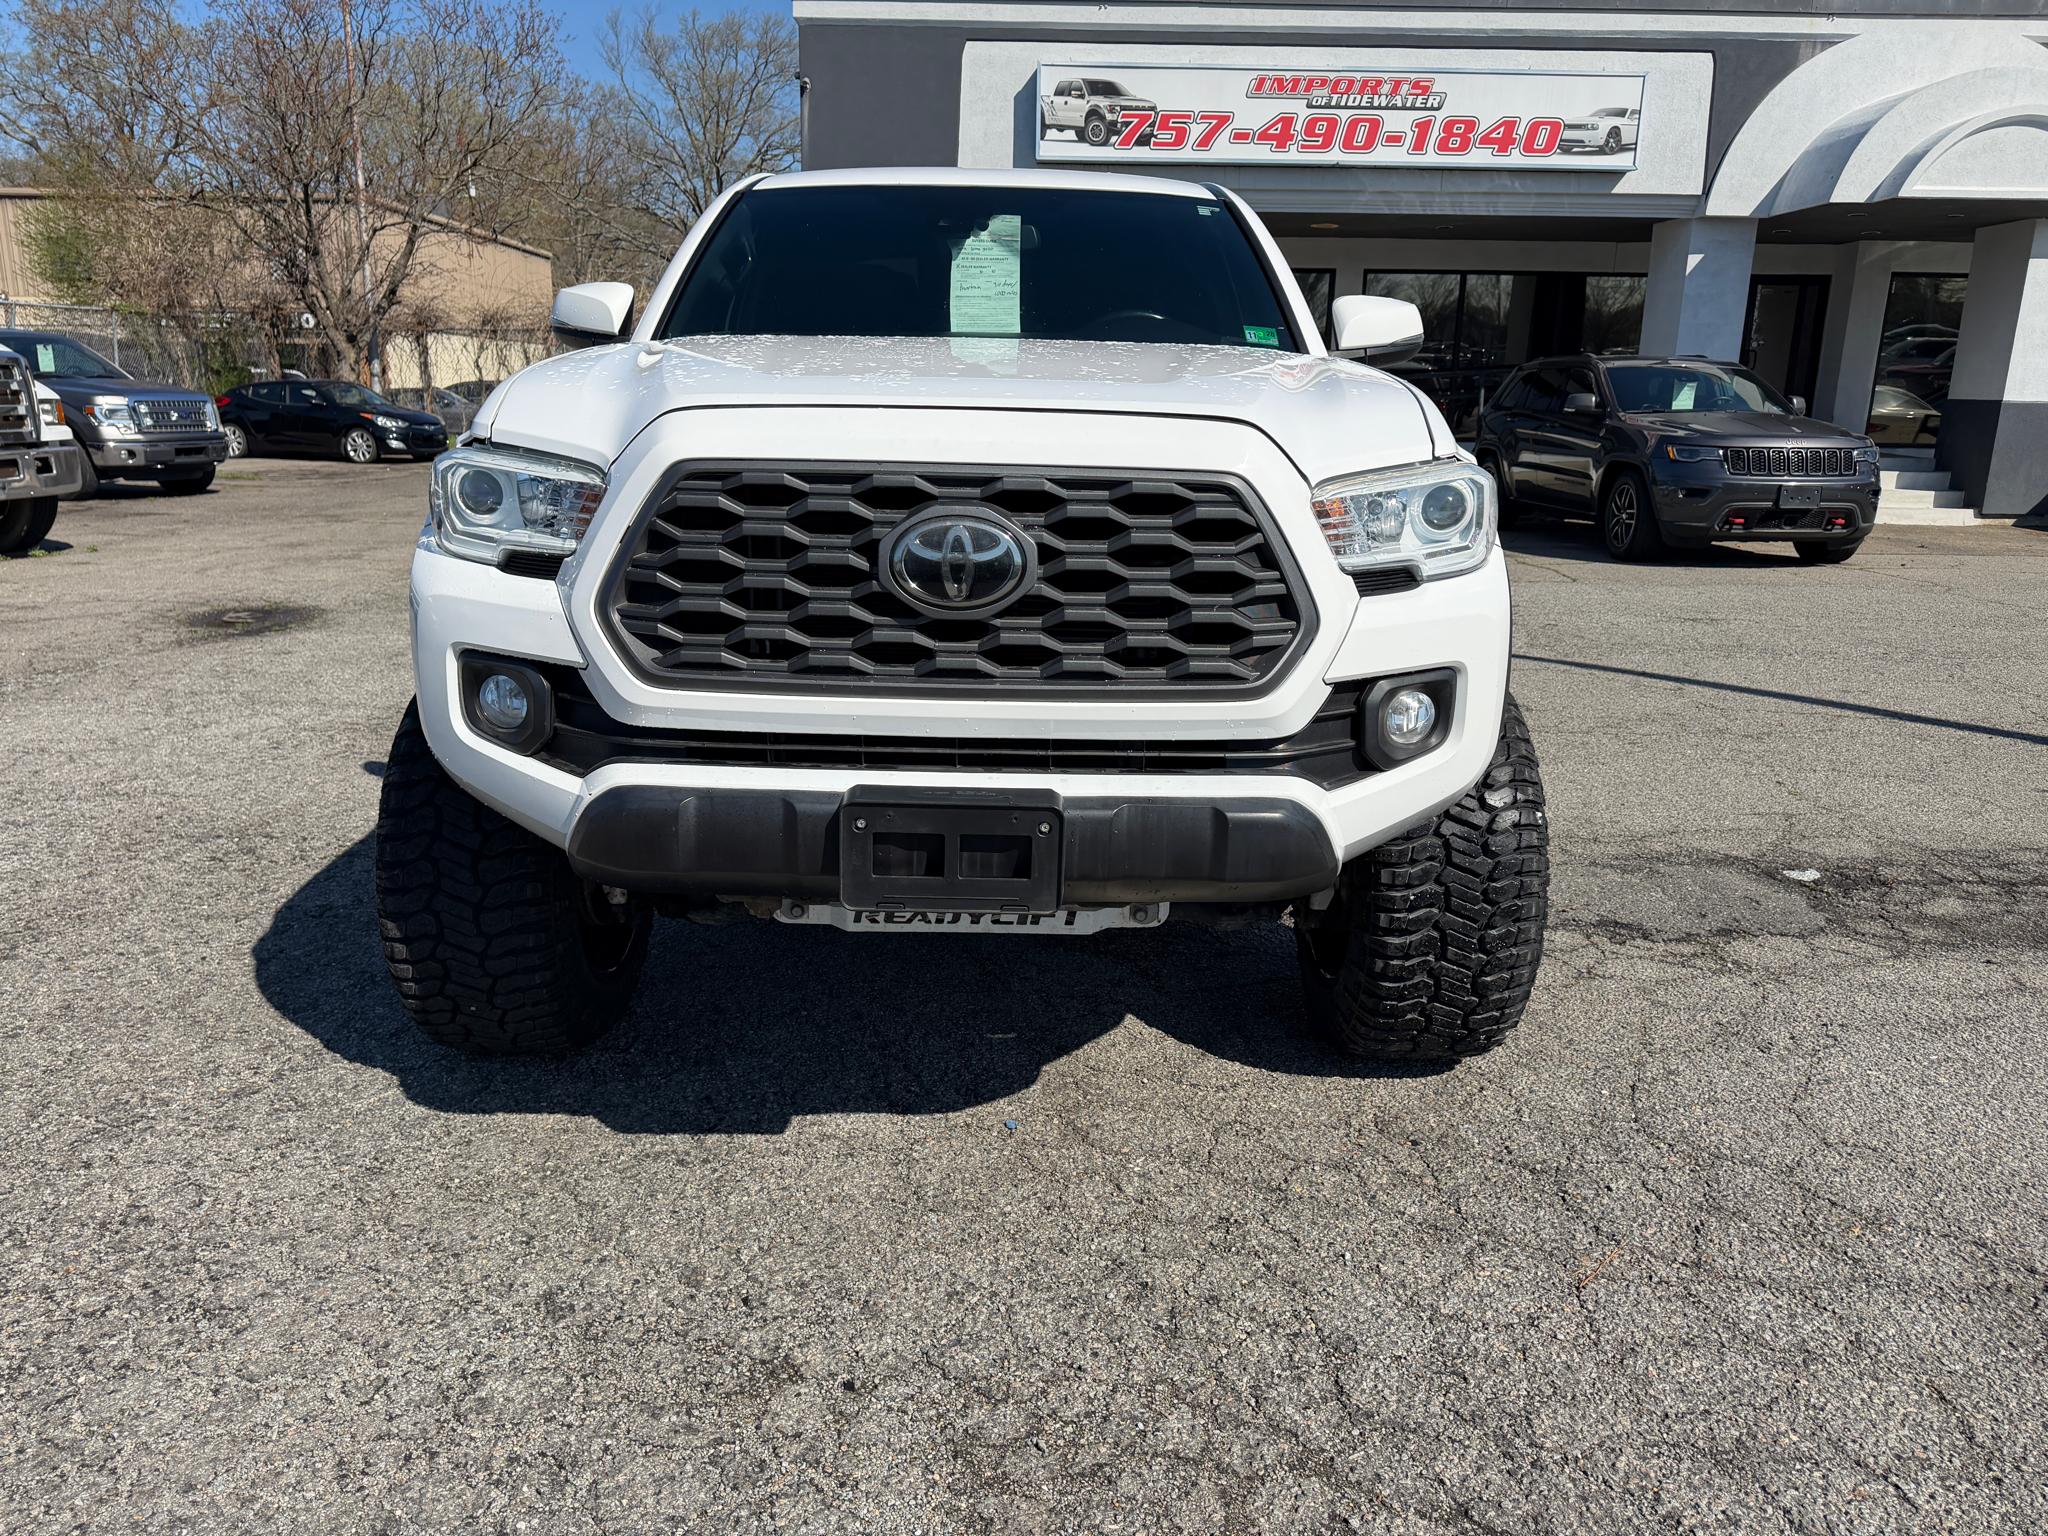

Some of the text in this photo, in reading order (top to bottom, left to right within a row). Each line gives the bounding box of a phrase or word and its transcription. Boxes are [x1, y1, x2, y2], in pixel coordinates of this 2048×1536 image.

[1252, 75, 1436, 97] IMPORTS
[1312, 94, 1442, 108] OF TIDEWATER
[1113, 110, 1566, 157] 757-490-1840
